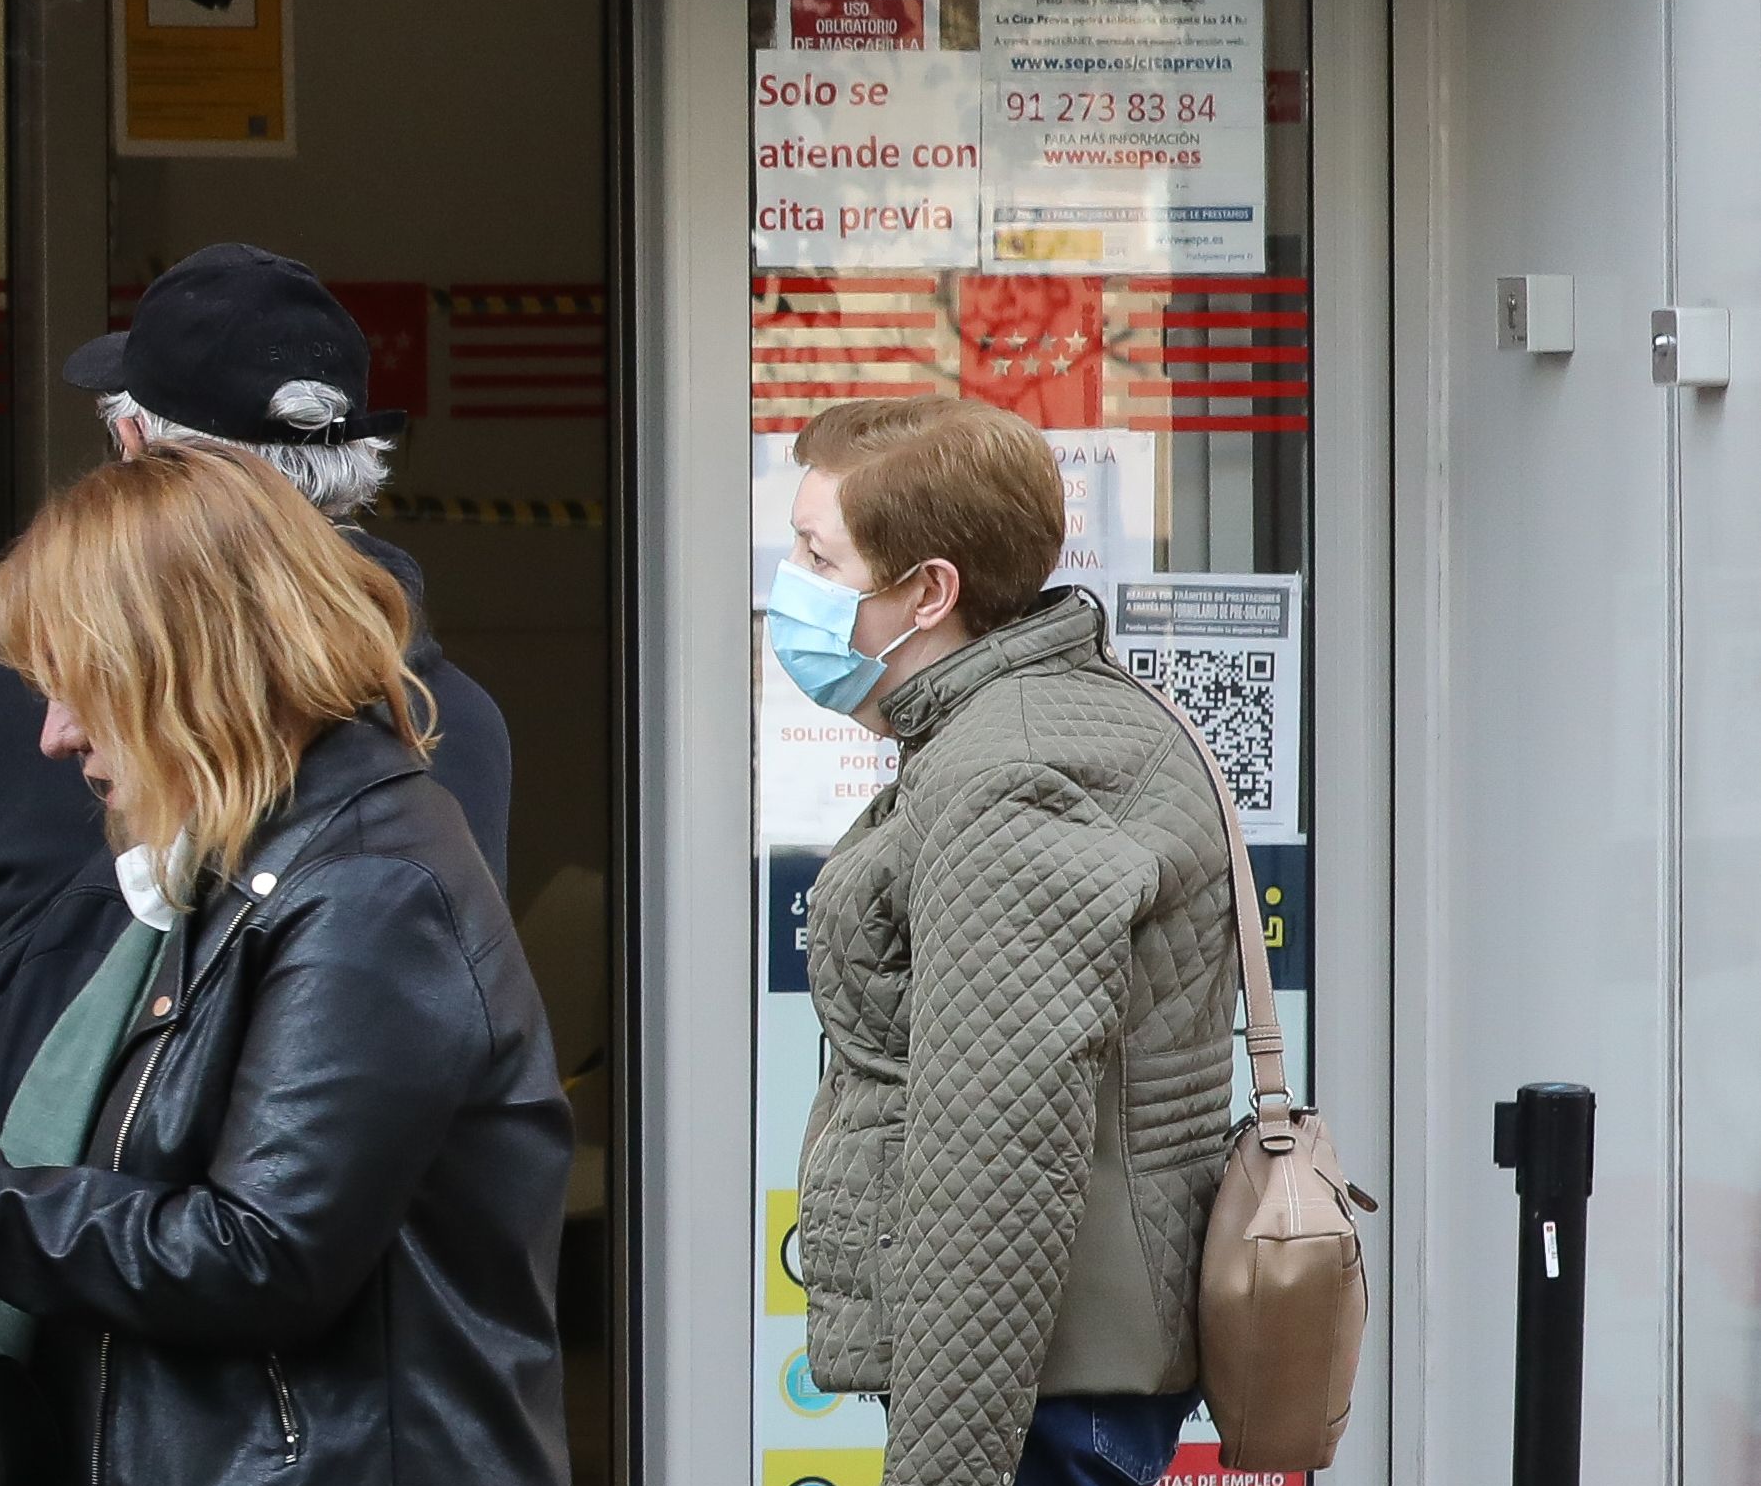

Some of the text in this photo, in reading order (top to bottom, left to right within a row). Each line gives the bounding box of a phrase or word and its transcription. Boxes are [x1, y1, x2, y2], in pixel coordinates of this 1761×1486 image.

[843, 2, 870, 15] USO
[816, 18, 897, 35] OBLIGATORIO
[1012, 15, 1033, 25] Cita
[795, 37, 920, 51] DE MASCARILLA
[1012, 55, 1232, 73] www.sepe.es/citaprevia
[758, 73, 889, 106] Solo se
[1007, 92, 1216, 122] 91 273 83 84
[1045, 130, 1200, 145] PARA MÁS INFORMACIÓN
[759, 136, 978, 168] atiende con
[1044, 148, 1201, 168] www.sepe.es
[759, 198, 953, 238] cita previa
[1094, 446, 1116, 464] LA
[840, 756, 879, 770] POR
